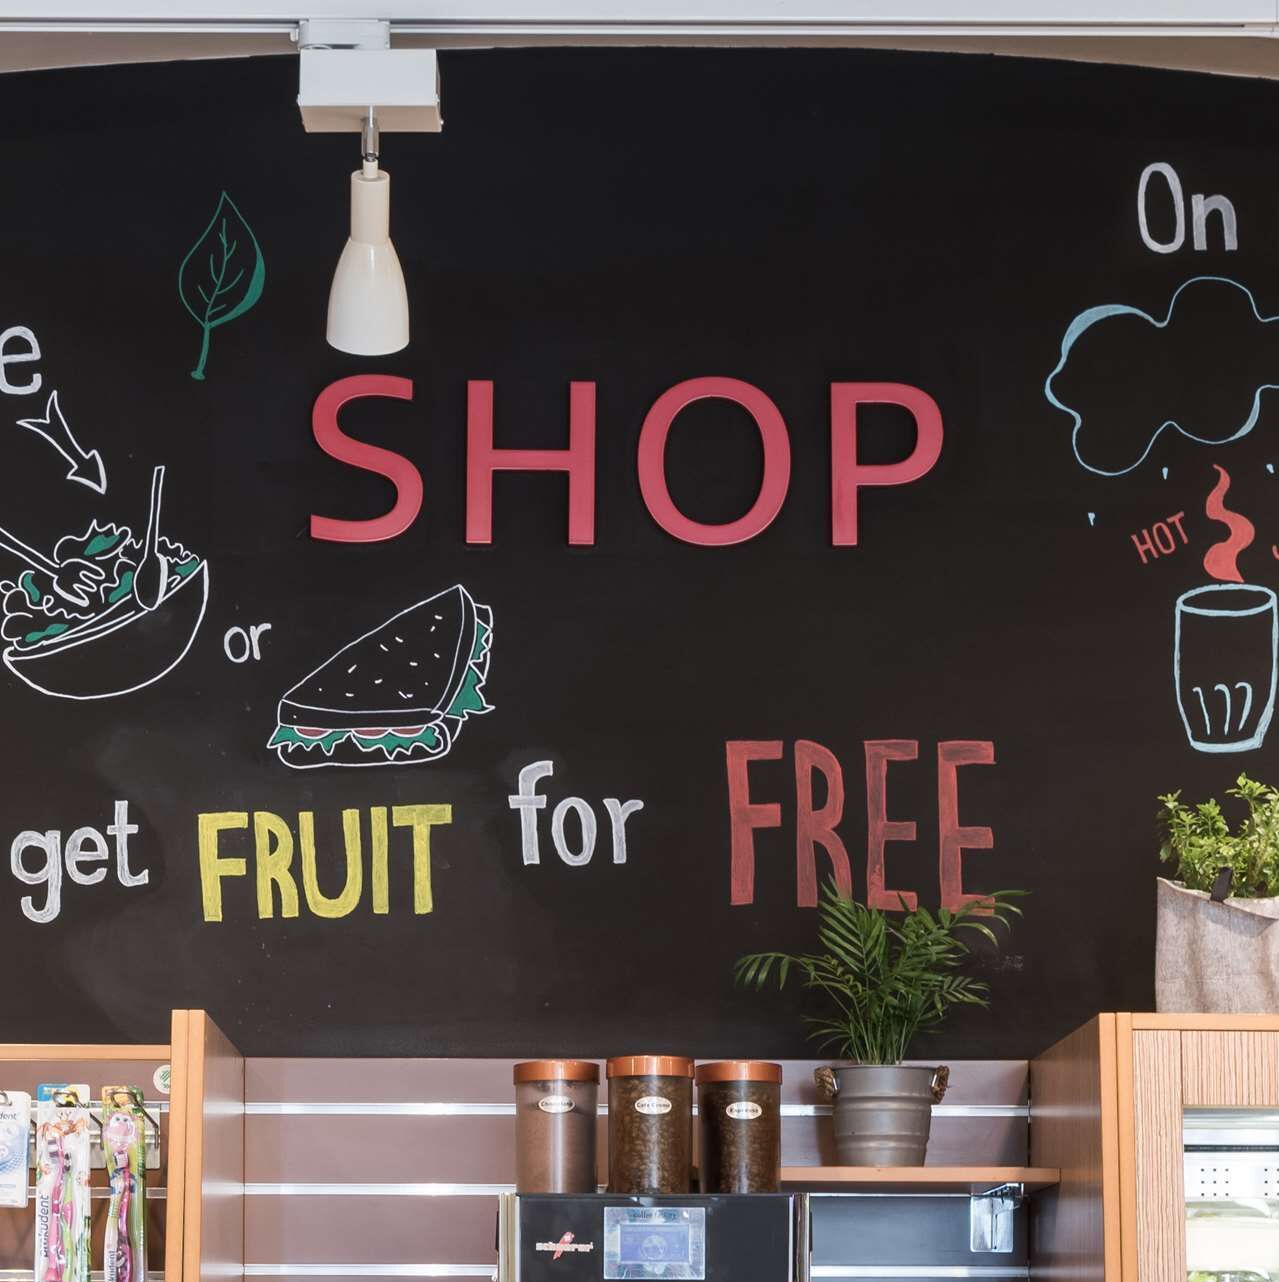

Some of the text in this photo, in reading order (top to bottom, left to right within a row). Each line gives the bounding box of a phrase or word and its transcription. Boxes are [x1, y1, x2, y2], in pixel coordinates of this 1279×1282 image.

[1136, 161, 1237, 253] On
[309, 373, 945, 547] SHOP
[1131, 510, 1192, 565] HOT
[223, 622, 272, 664] or
[10, 739, 996, 925] get FRUIT for FREE
